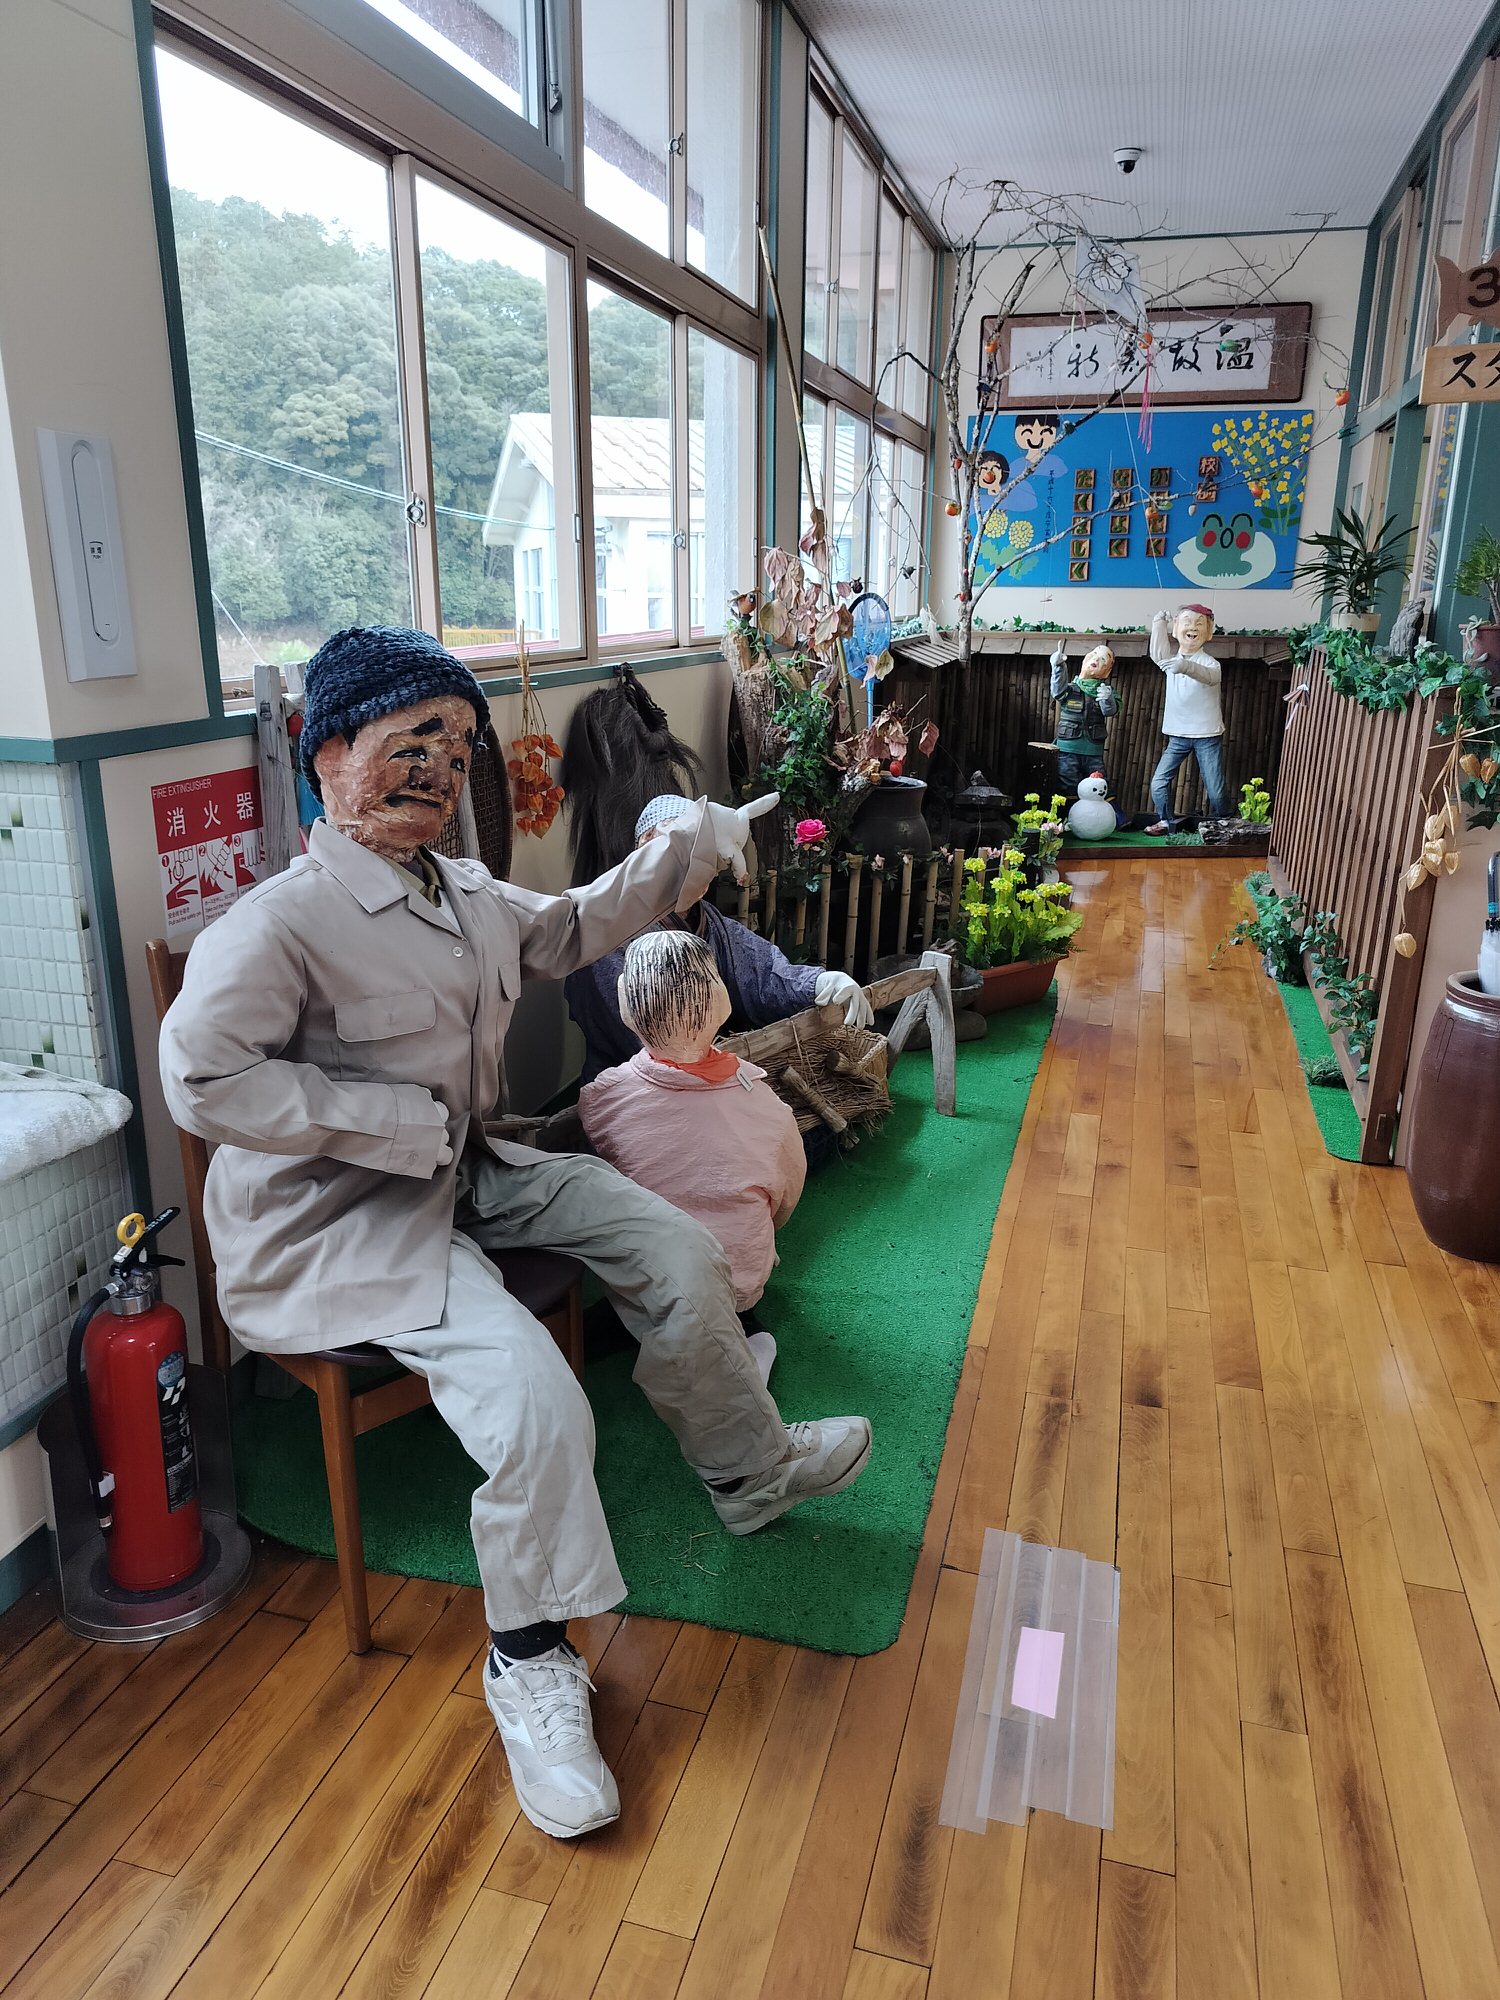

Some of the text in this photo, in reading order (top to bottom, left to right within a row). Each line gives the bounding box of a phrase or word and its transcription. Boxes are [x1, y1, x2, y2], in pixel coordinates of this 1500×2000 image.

[1468, 267, 1500, 308] 3
[152, 778, 212, 799] FIRE EXTINGUISHER
[167, 791, 254, 838] 消火器
